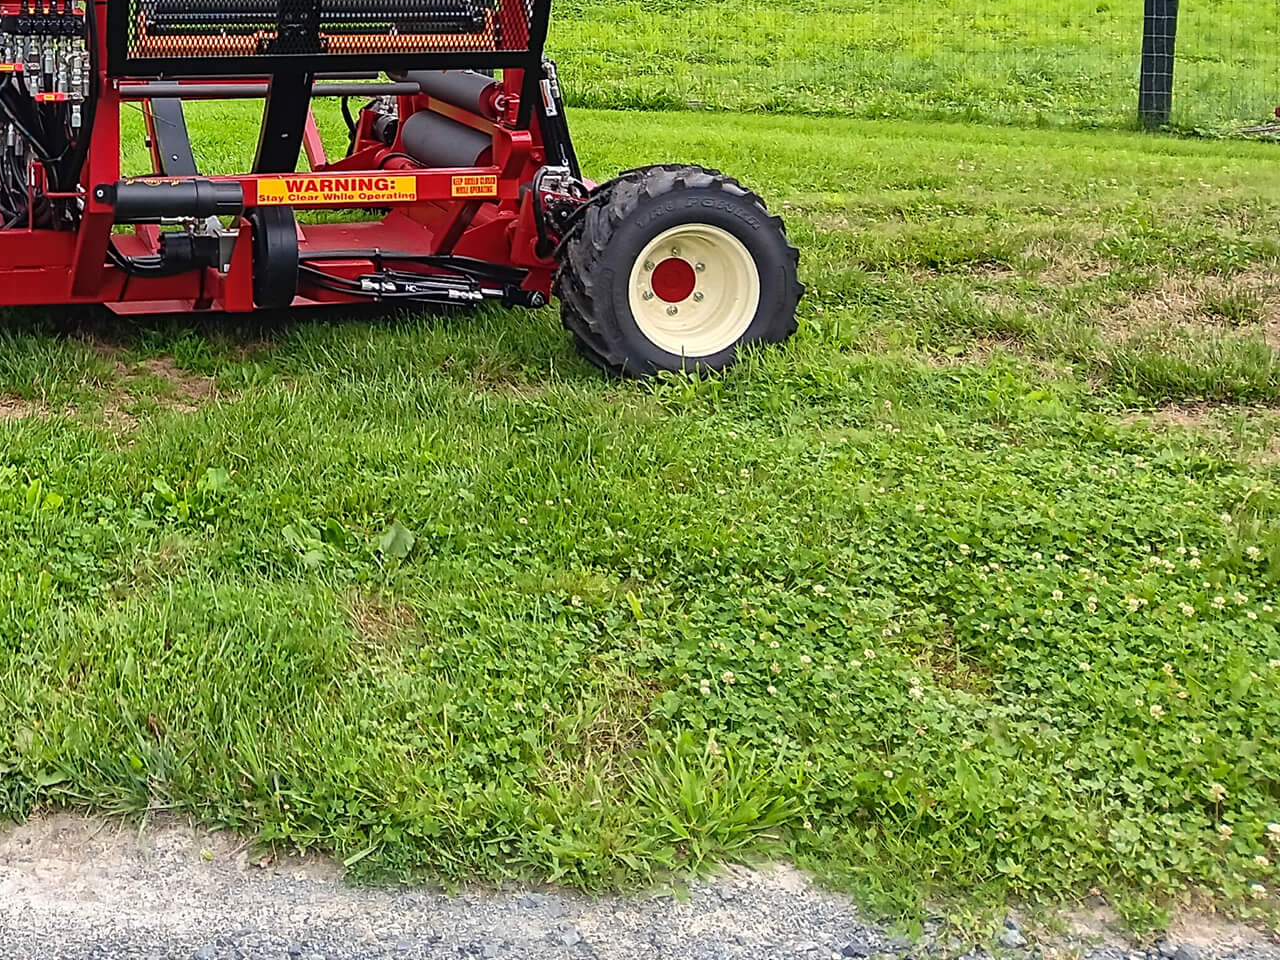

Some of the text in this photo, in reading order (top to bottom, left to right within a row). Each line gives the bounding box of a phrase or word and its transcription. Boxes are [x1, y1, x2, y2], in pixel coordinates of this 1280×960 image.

[285, 178, 396, 192] WARNING:
[259, 191, 415, 202] Stay Clear While Operating
